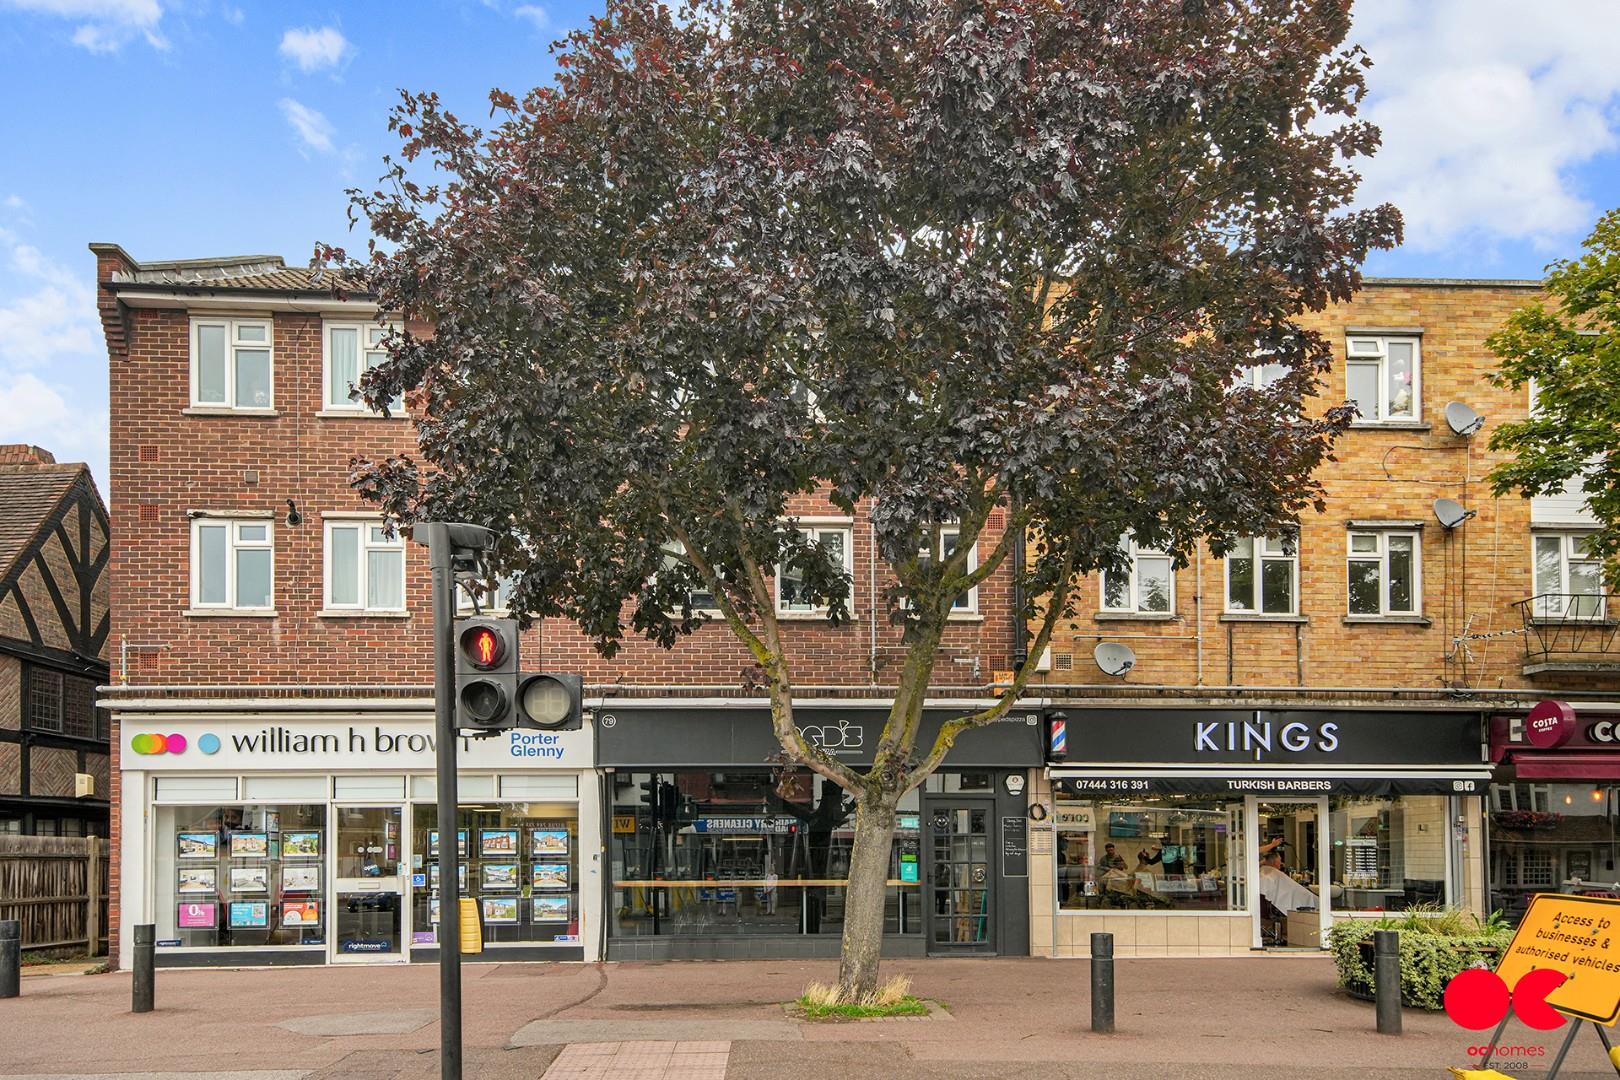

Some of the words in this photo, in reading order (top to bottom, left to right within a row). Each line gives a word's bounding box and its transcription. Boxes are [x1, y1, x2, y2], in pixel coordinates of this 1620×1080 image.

[604, 717, 614, 725] 79
[1532, 717, 1558, 729] COSTA
[231, 726, 339, 753] william
[348, 726, 365, 753] h
[511, 732, 559, 745] Porter
[1196, 720, 1339, 752] KINGS
[511, 745, 564, 759] Glenny
[1076, 780, 1107, 789] 07444
[1110, 780, 1128, 789] 316
[1131, 780, 1149, 789] 391
[1227, 780, 1275, 790] TURKISH
[1277, 781, 1332, 790] BARBERS
[1552, 912, 1594, 927] Access
[1598, 917, 1611, 929] to
[1535, 928, 1598, 947] businesses
[1601, 938, 1610, 949] &
[348, 943, 381, 951] rightmove
[1515, 946, 1570, 962] authorised
[1572, 956, 1620, 973] vehicles
